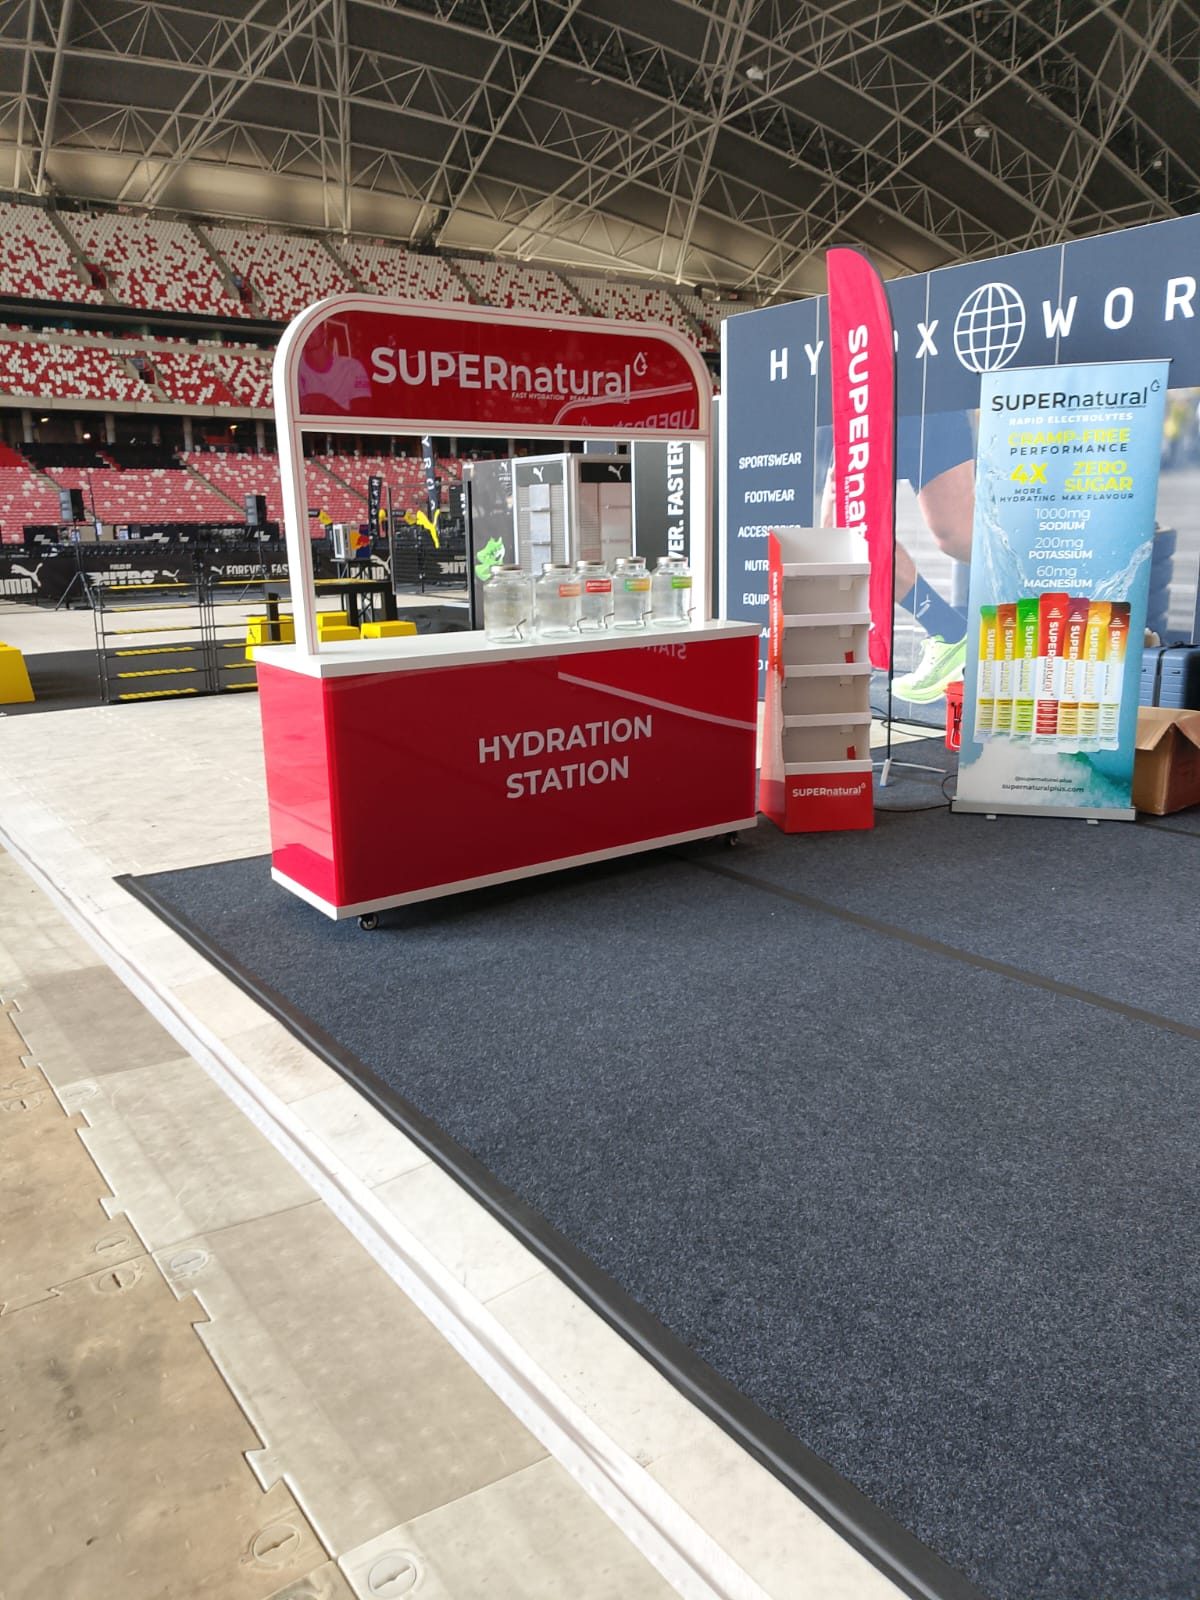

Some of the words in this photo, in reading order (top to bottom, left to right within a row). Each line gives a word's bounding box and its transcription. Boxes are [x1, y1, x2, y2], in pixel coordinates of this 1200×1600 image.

[769, 320, 939, 381] HYX
[371, 347, 630, 397] SUPERnatural
[991, 387, 1148, 412] SUPERnatural
[1009, 417, 1043, 426] RAPID
[1047, 412, 1133, 424] ELECTROLYTES
[1008, 428, 1131, 446] CRAMP-FREE
[1010, 443, 1128, 456] PERFORMANCE
[738, 452, 802, 469] SPORTSWEAR
[1010, 463, 1048, 484] 4X
[1072, 460, 1127, 476] ZERO
[667, 441, 684, 515] FASTER
[1064, 476, 1133, 492] SUGAR
[744, 489, 795, 503] FOOTWEAR
[1000, 494, 1056, 502] HYDRATING
[1014, 487, 1042, 495] MORE
[1034, 508, 1091, 521] 1000mg
[1039, 521, 1085, 531] SODIUM
[1035, 537, 1084, 550] 200mg
[1028, 550, 1092, 559] POTASSIUM
[1036, 565, 1077, 578] 60mg
[1024, 579, 1092, 588] MAGNESIUM
[743, 592, 769, 606] EQUIP
[478, 715, 653, 763] HYDRATION
[506, 756, 629, 799] STATION
[792, 785, 862, 798] SUPERnatural
